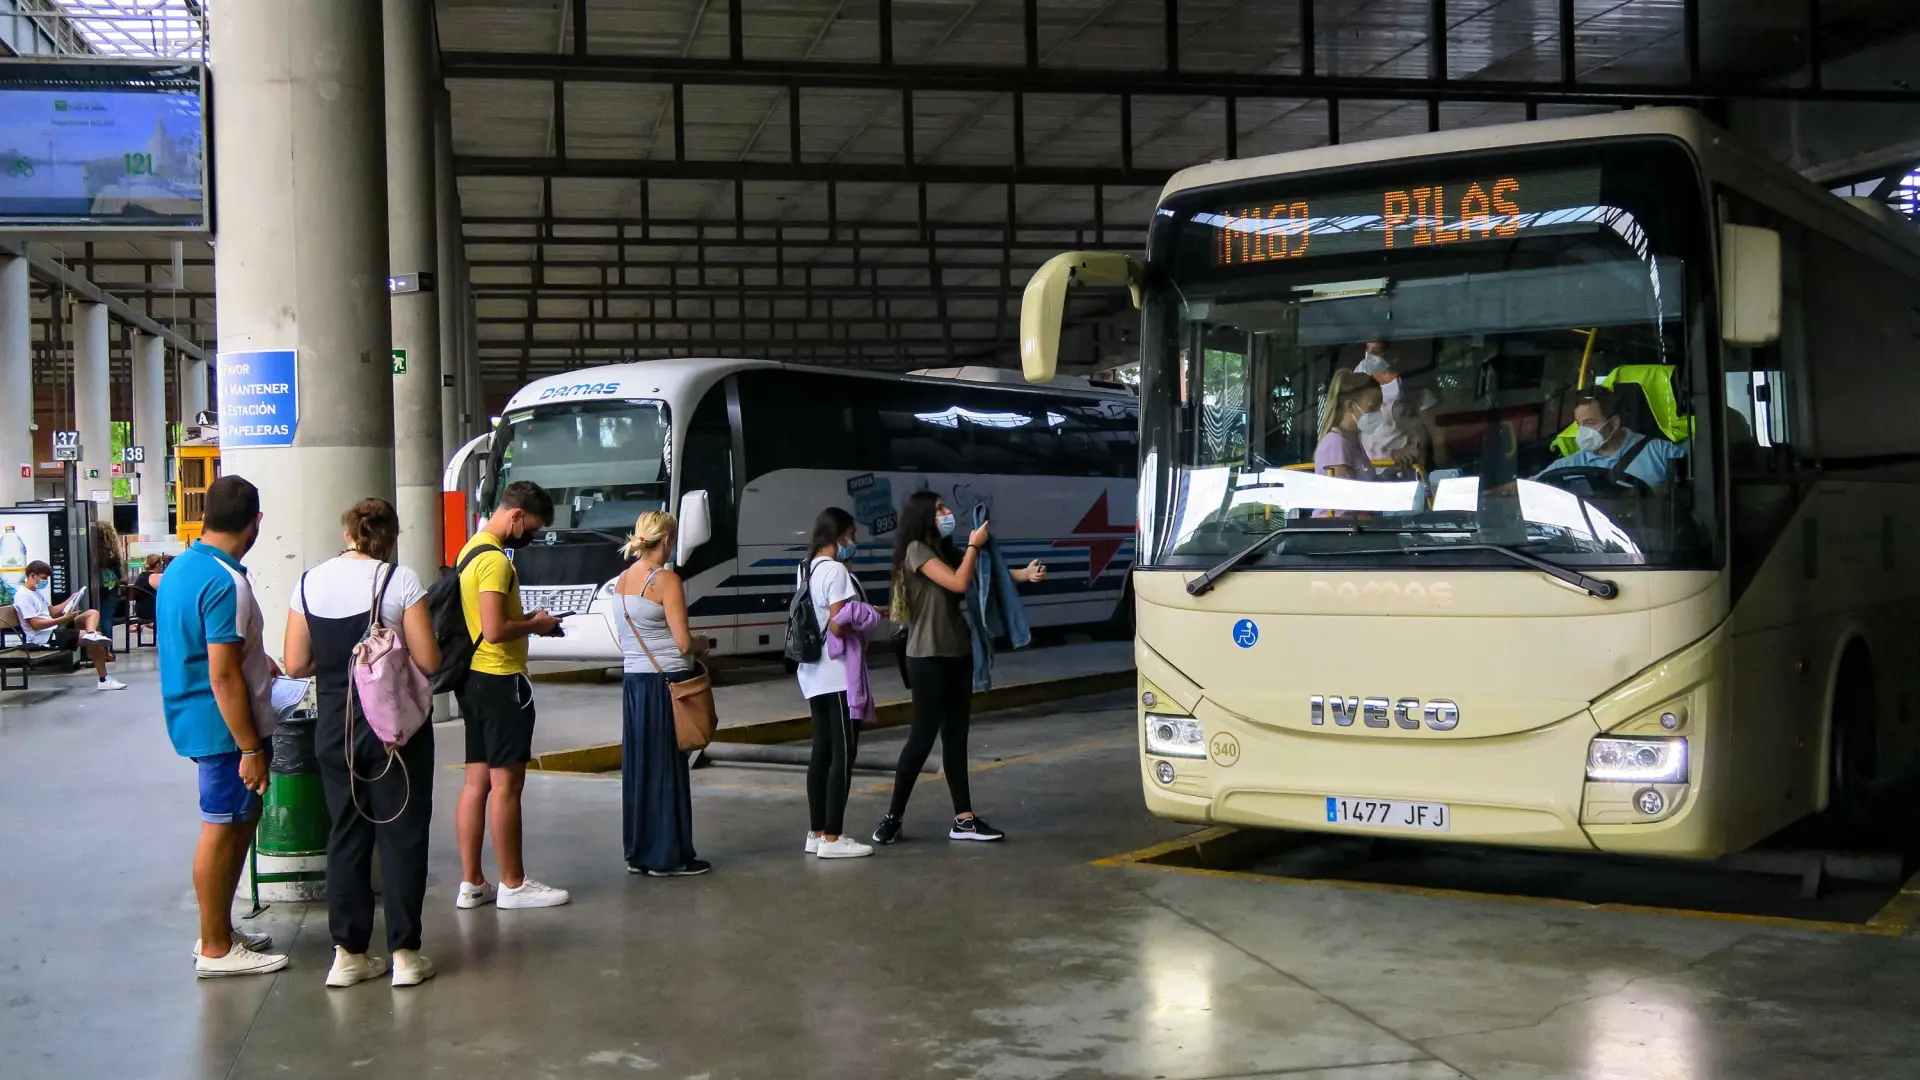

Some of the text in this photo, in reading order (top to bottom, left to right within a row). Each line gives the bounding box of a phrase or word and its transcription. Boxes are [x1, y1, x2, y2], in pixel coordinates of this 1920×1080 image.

[1222, 177, 1520, 264] M169 PILAS
[224, 363, 250, 375] FAVOR
[229, 382, 289, 396] MANTENER
[539, 382, 621, 401] DAMAS
[228, 401, 276, 416] ESTACIÓN
[229, 424, 289, 437] PAPELERAS
[58, 431, 78, 446] 37
[126, 447, 143, 461] 38
[1310, 694, 1460, 731] IVECO
[1213, 742, 1237, 758] 340
[1341, 800, 1391, 823] 1477
[1404, 805, 1444, 827] JFJ
